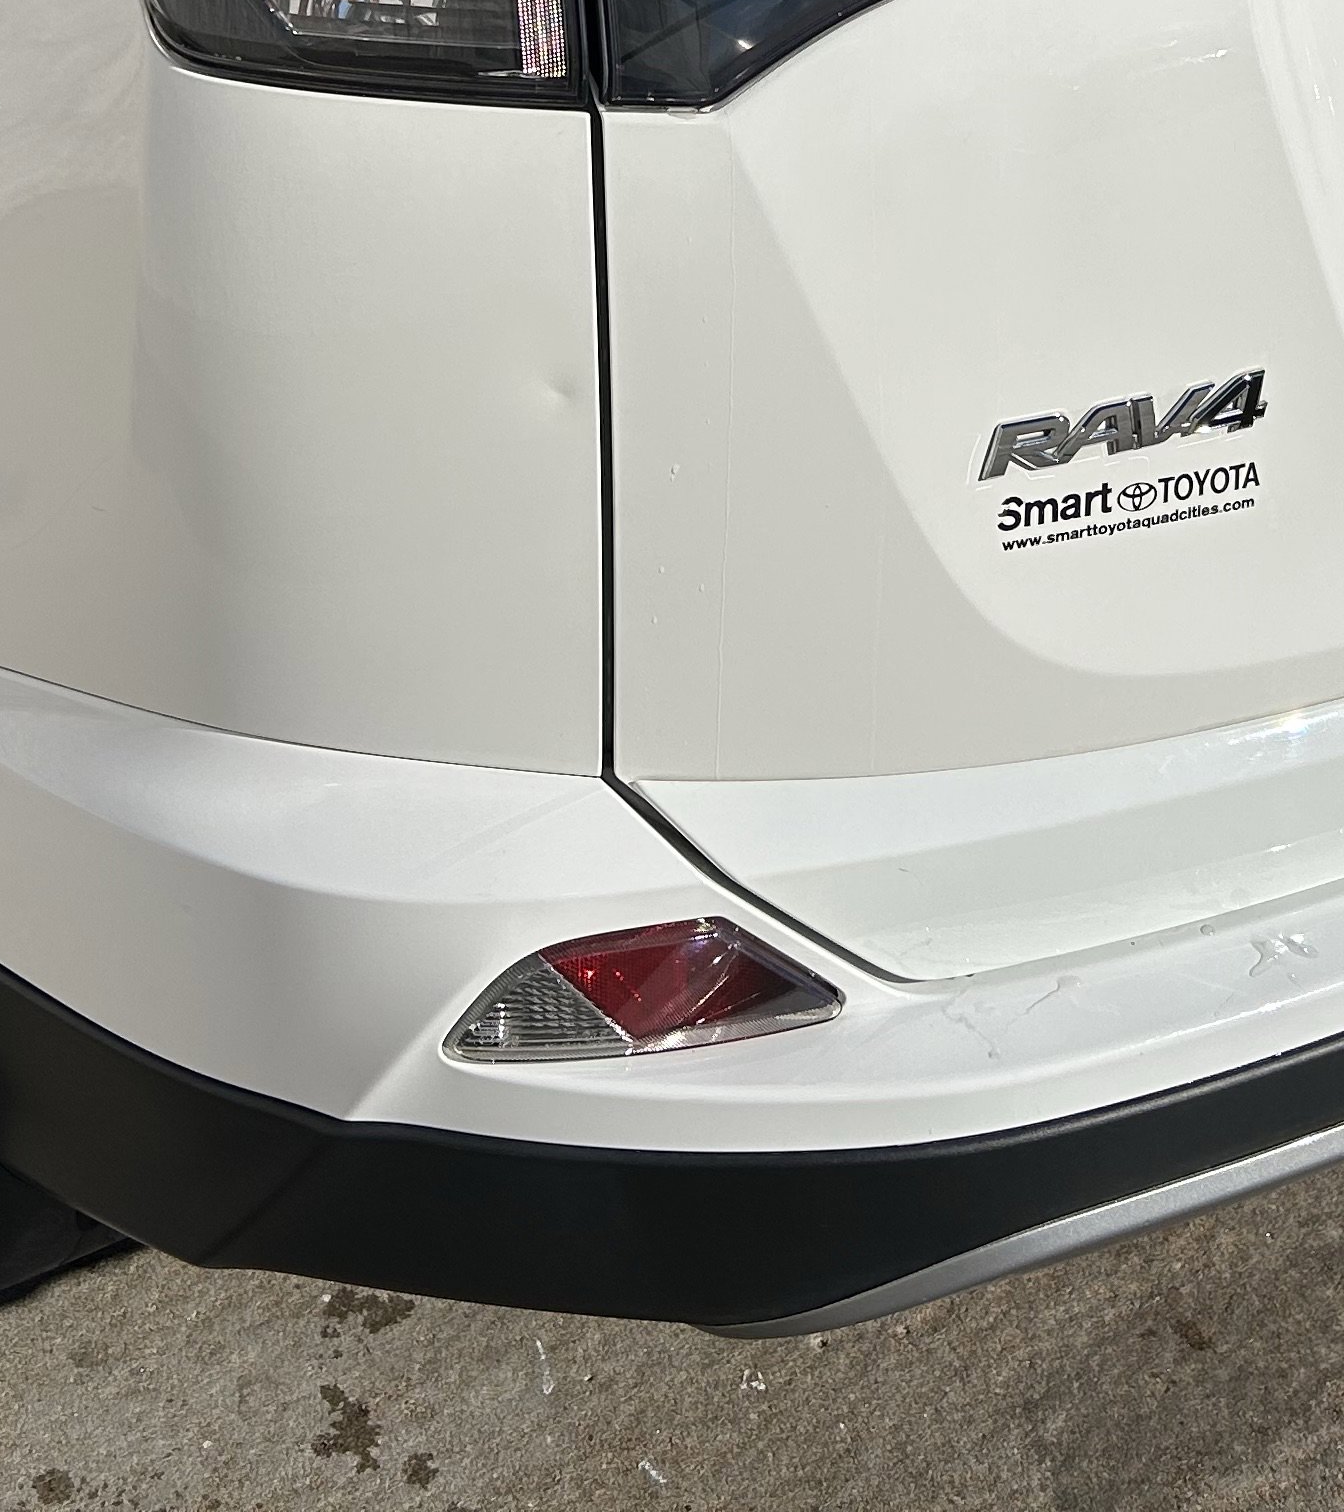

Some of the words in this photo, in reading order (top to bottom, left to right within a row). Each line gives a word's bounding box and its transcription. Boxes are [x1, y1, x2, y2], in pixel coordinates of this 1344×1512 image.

[977, 365, 1269, 483] RAV4
[997, 481, 1112, 532] Smart
[1157, 461, 1261, 504] TOYOTA
[1001, 496, 1255, 552] www.smarttoyotaquadcities.com
